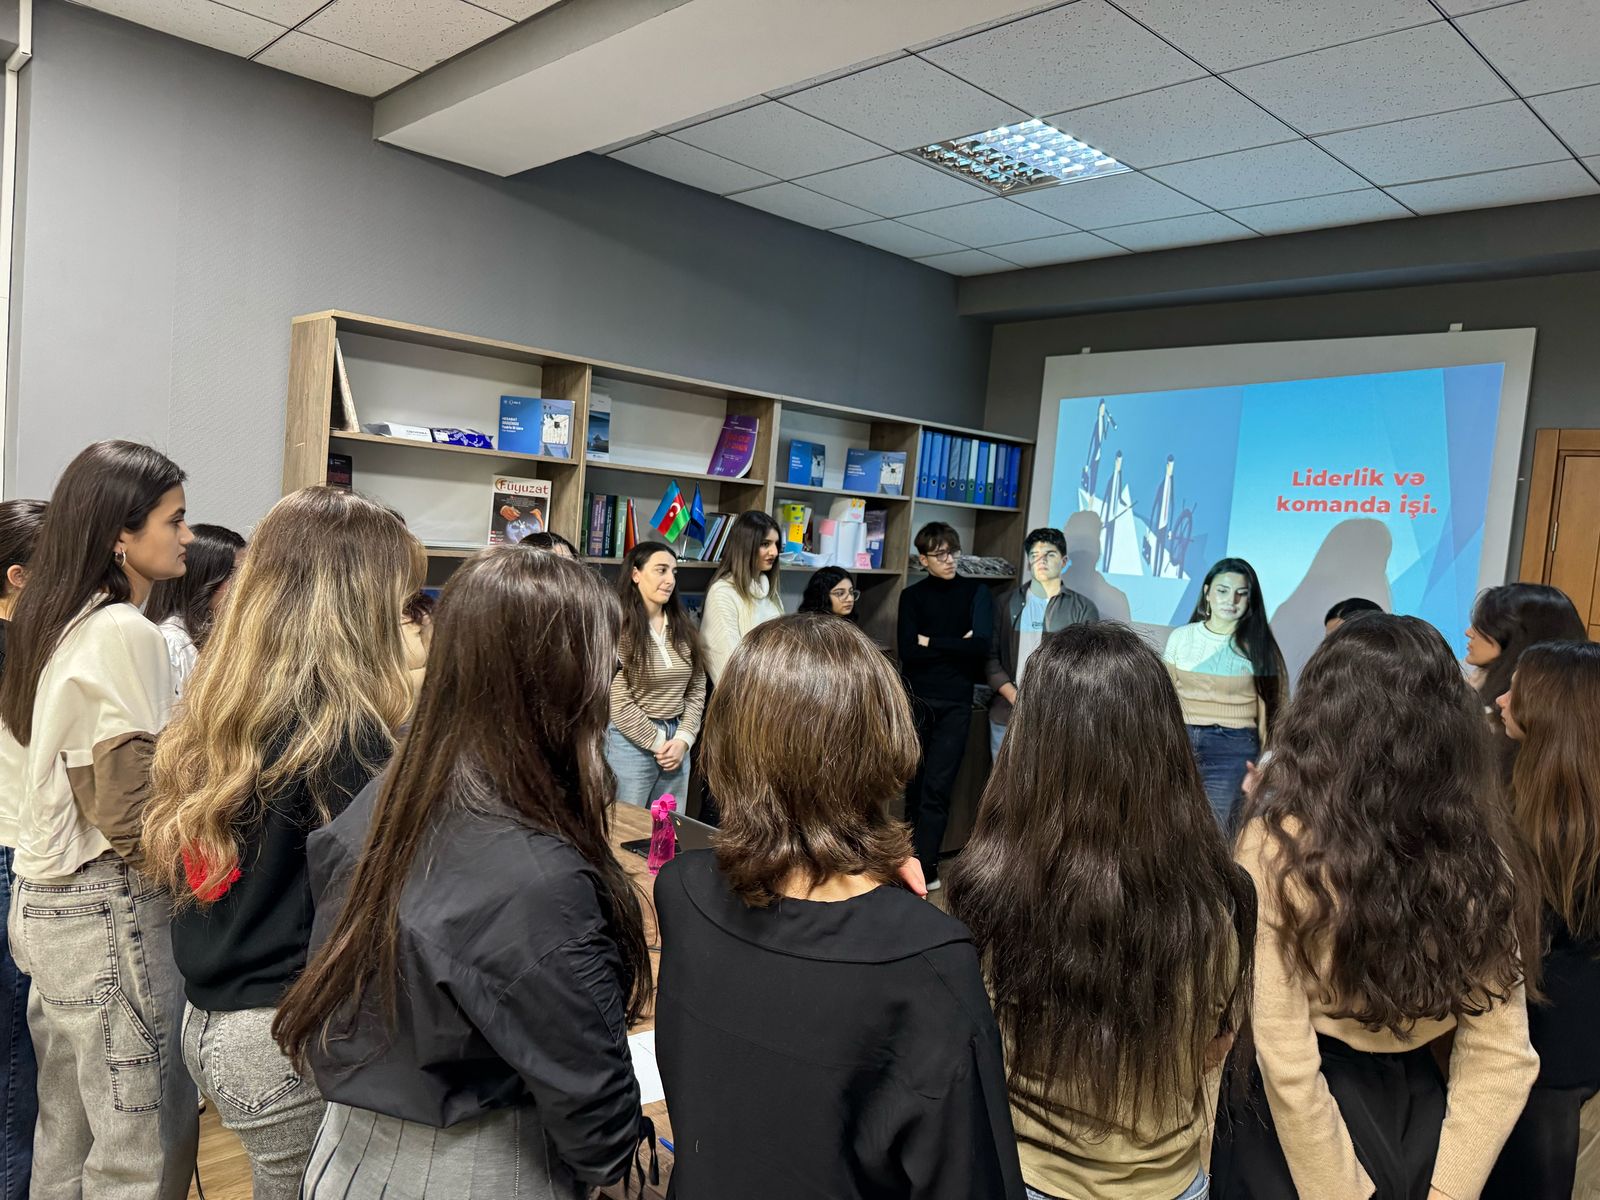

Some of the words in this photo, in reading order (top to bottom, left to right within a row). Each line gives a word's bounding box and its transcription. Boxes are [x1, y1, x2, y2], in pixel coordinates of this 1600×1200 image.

[496, 479, 549, 495] Füyuzat
[1292, 467, 1385, 487] Liderlik
[1393, 472, 1426, 487] və
[1276, 495, 1391, 513] komanda
[1399, 494, 1438, 519] işi.
